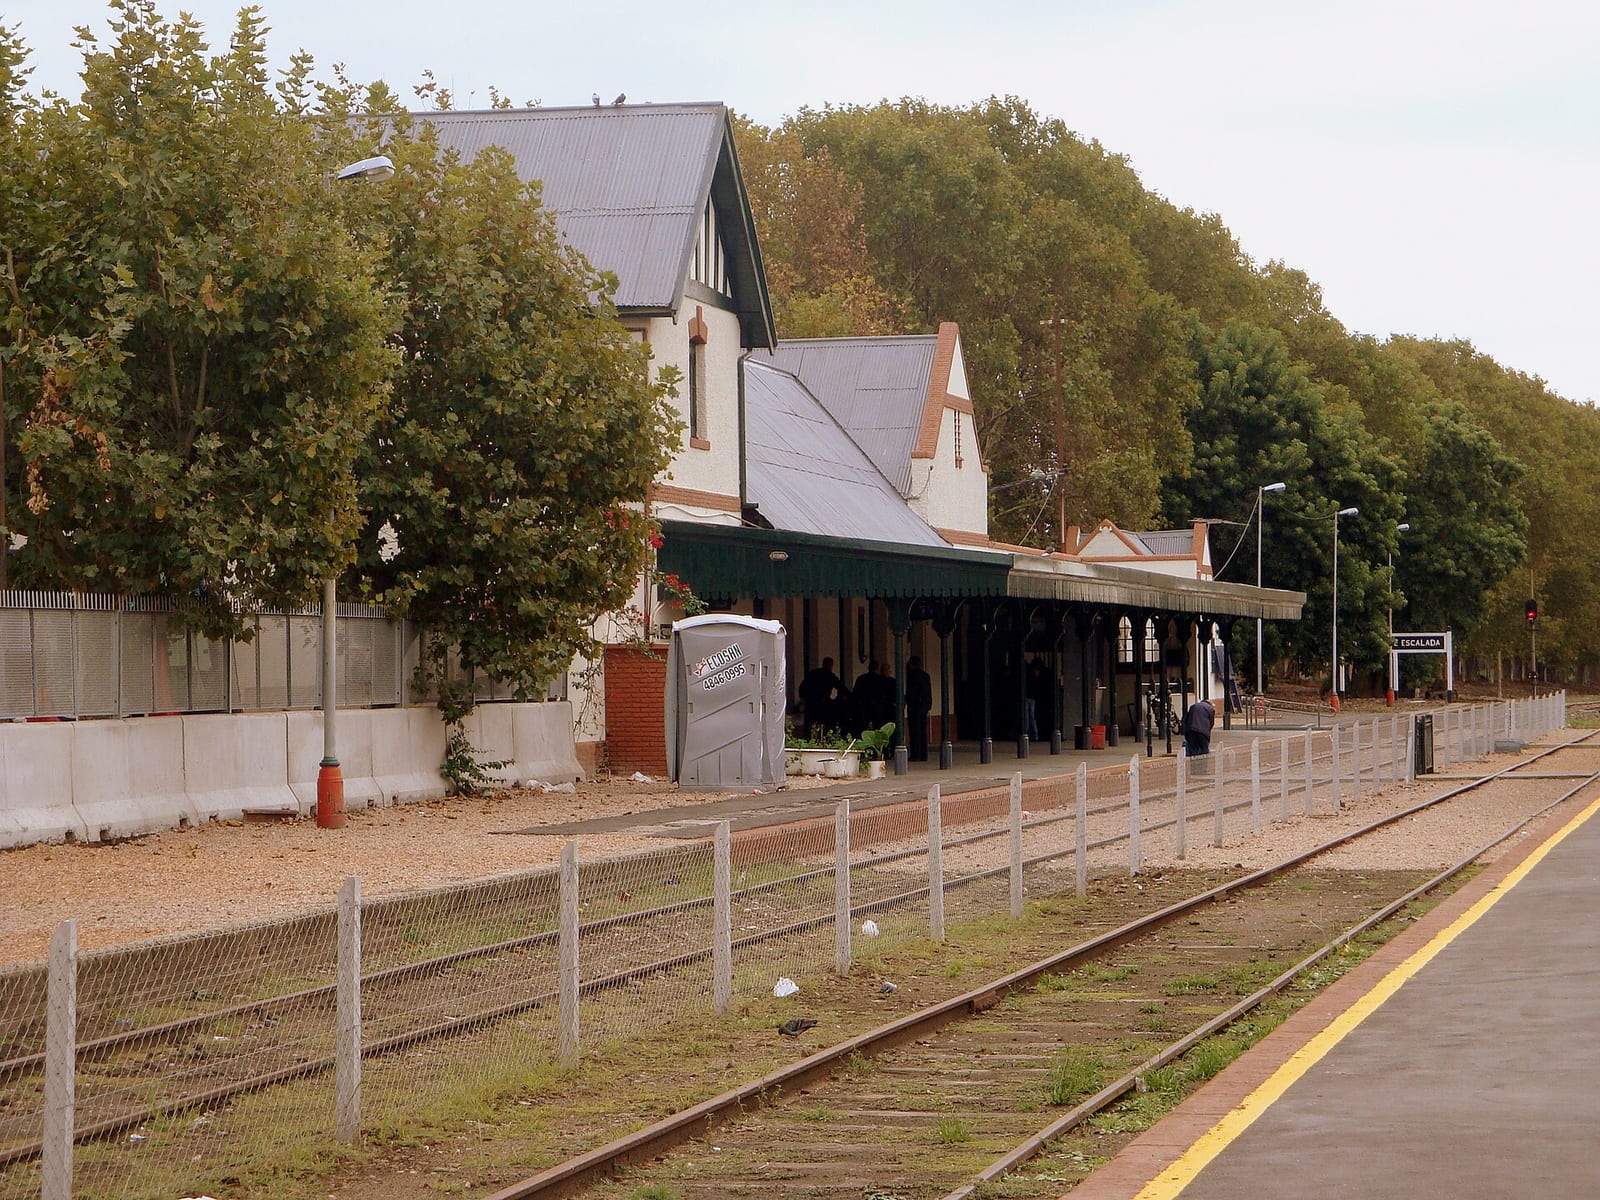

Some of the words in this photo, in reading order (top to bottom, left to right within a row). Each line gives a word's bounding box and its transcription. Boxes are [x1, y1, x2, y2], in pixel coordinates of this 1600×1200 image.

[1401, 639, 1441, 647] ESCALADA
[706, 643, 742, 671] ECOSAN
[703, 664, 745, 690] 4846-0995
